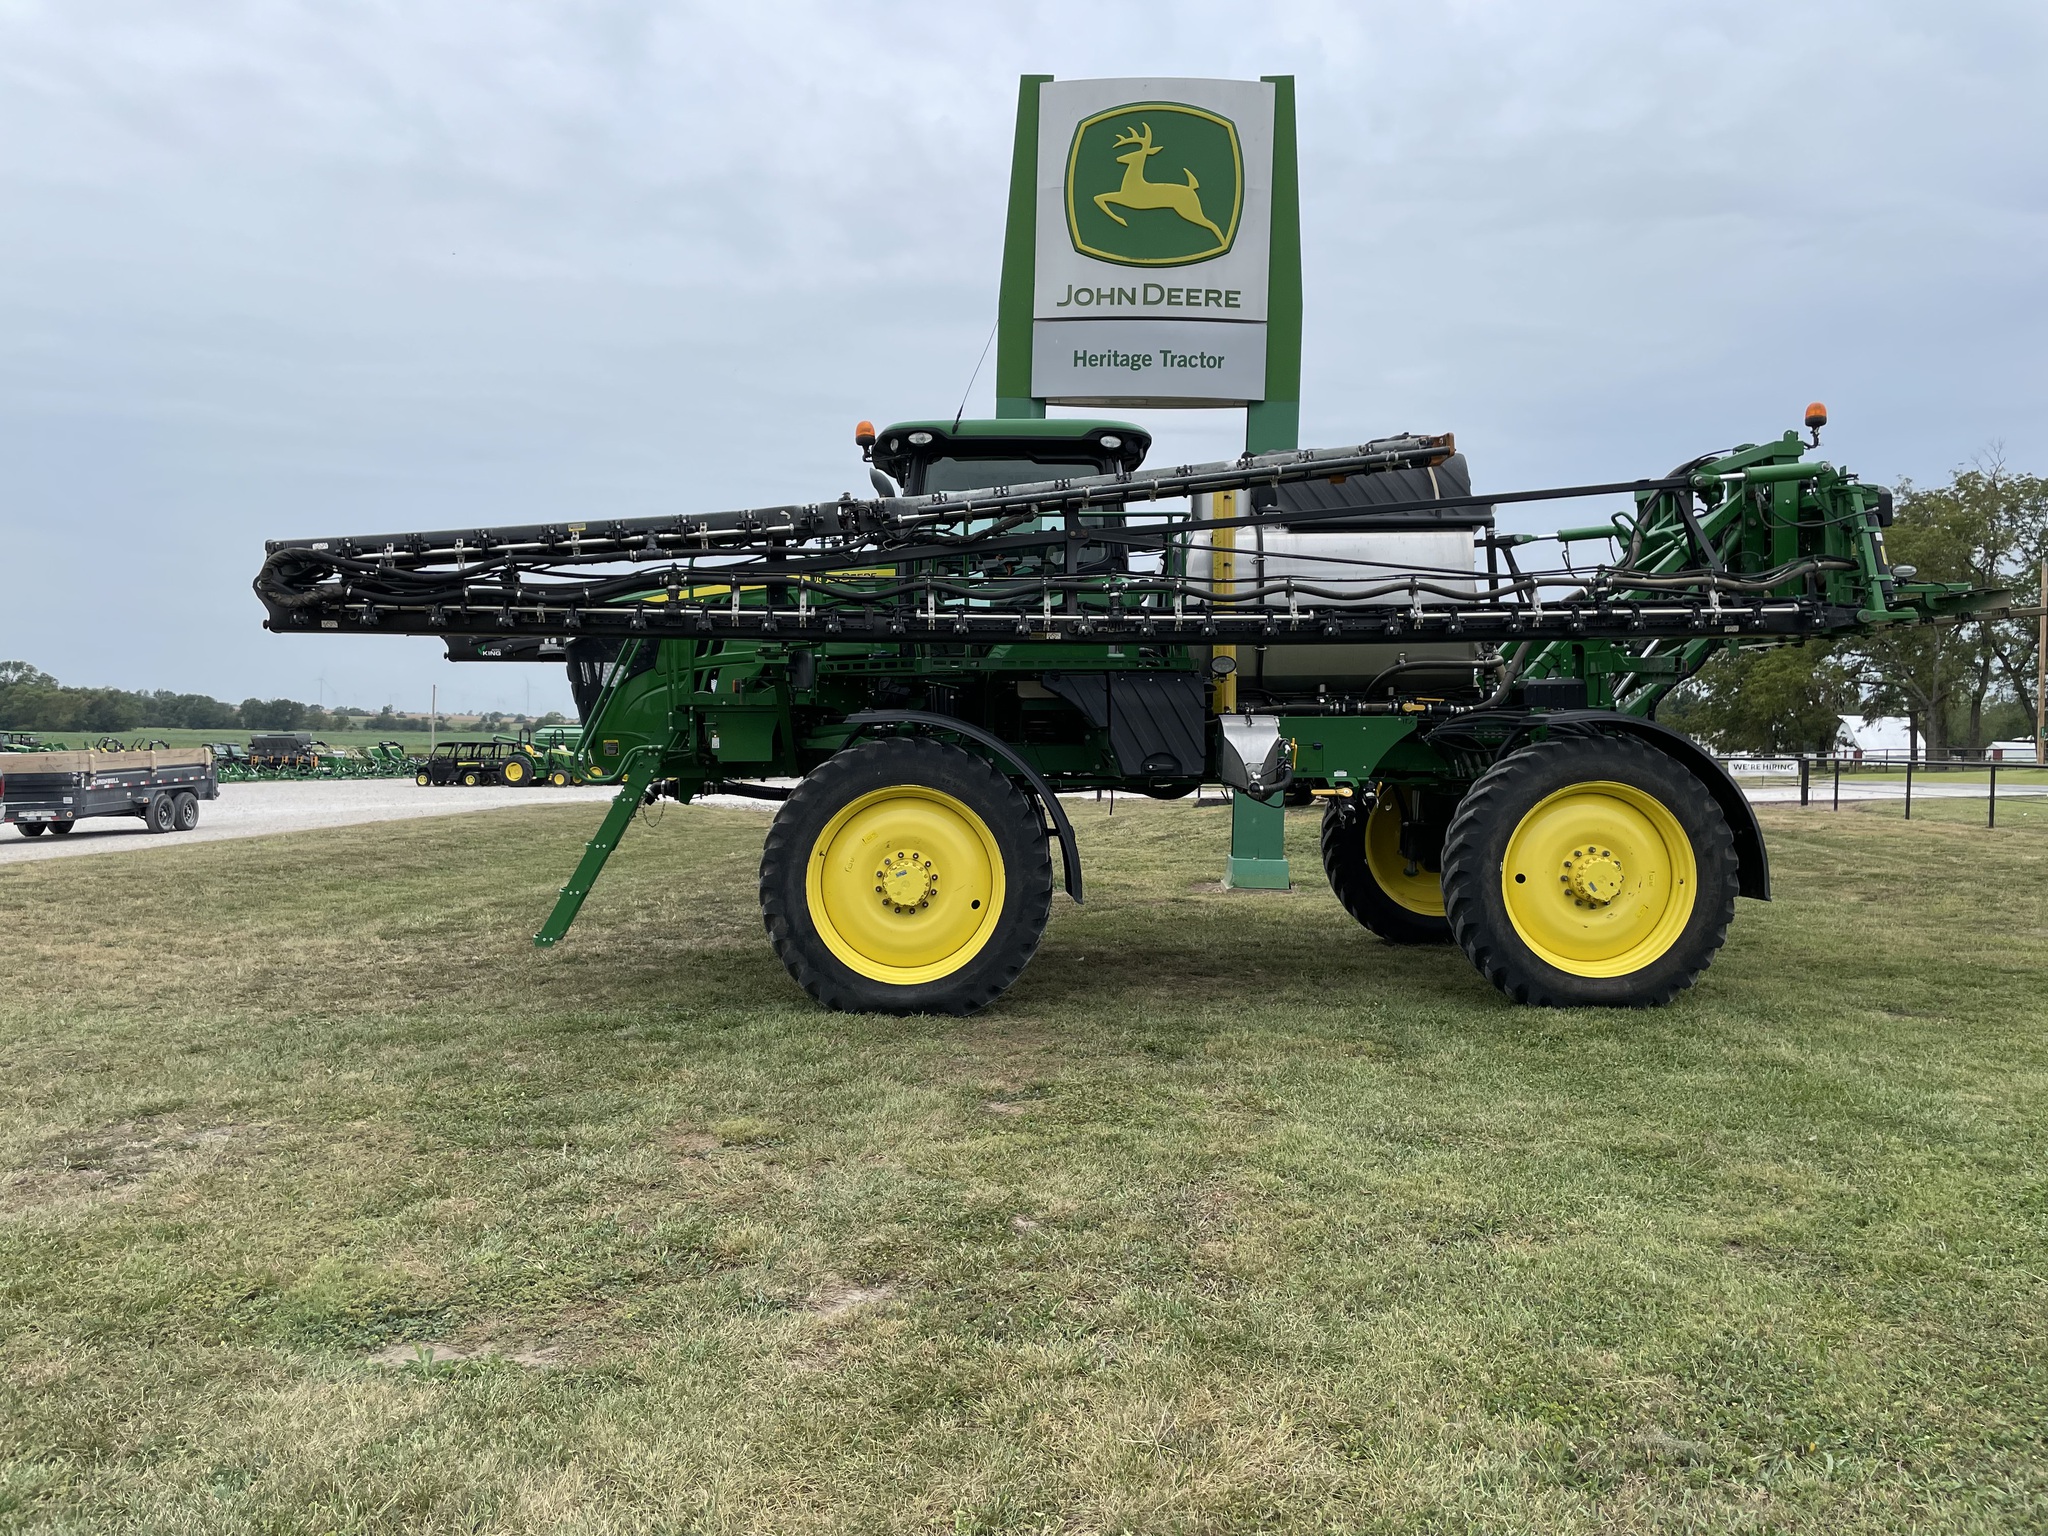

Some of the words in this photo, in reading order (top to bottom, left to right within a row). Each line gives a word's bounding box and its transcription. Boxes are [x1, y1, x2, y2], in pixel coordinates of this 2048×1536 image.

[1056, 284, 1137, 307] JOHN
[1142, 283, 1242, 309] DEERE
[1073, 349, 1153, 371] Heritage
[1159, 349, 1225, 369] Tractor
[1733, 763, 1761, 771] WE'RE
[1762, 763, 1794, 771] HIRING
